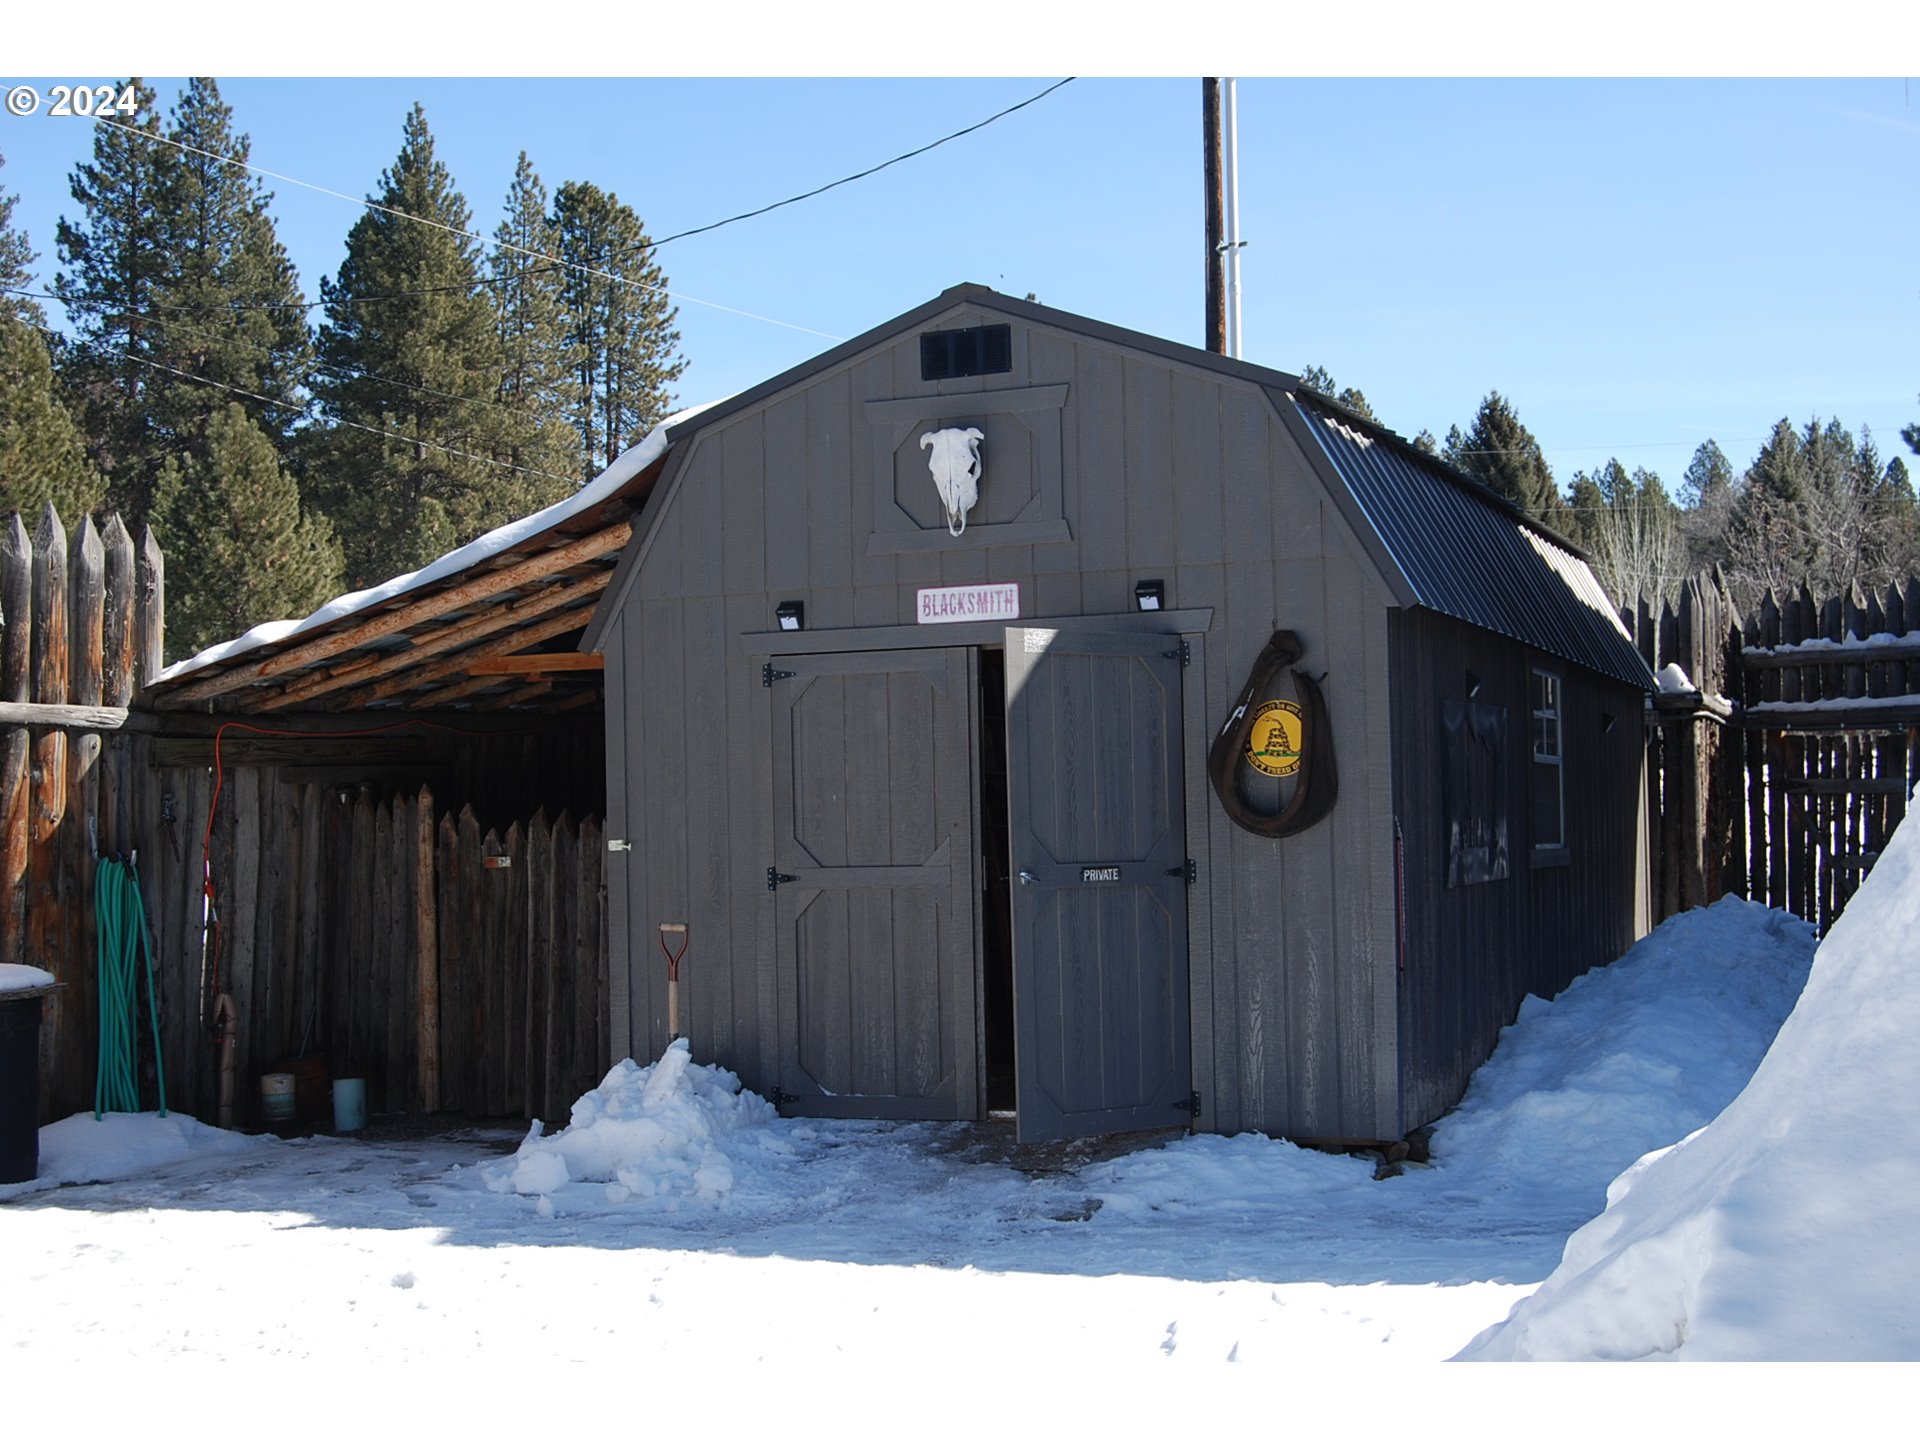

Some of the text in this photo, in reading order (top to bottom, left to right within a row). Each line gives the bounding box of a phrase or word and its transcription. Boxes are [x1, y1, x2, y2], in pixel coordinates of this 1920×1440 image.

[923, 589, 1014, 617] BLACKSMITH
[1267, 766, 1291, 774] TREAD
[1084, 868, 1119, 881] PRIVATE
